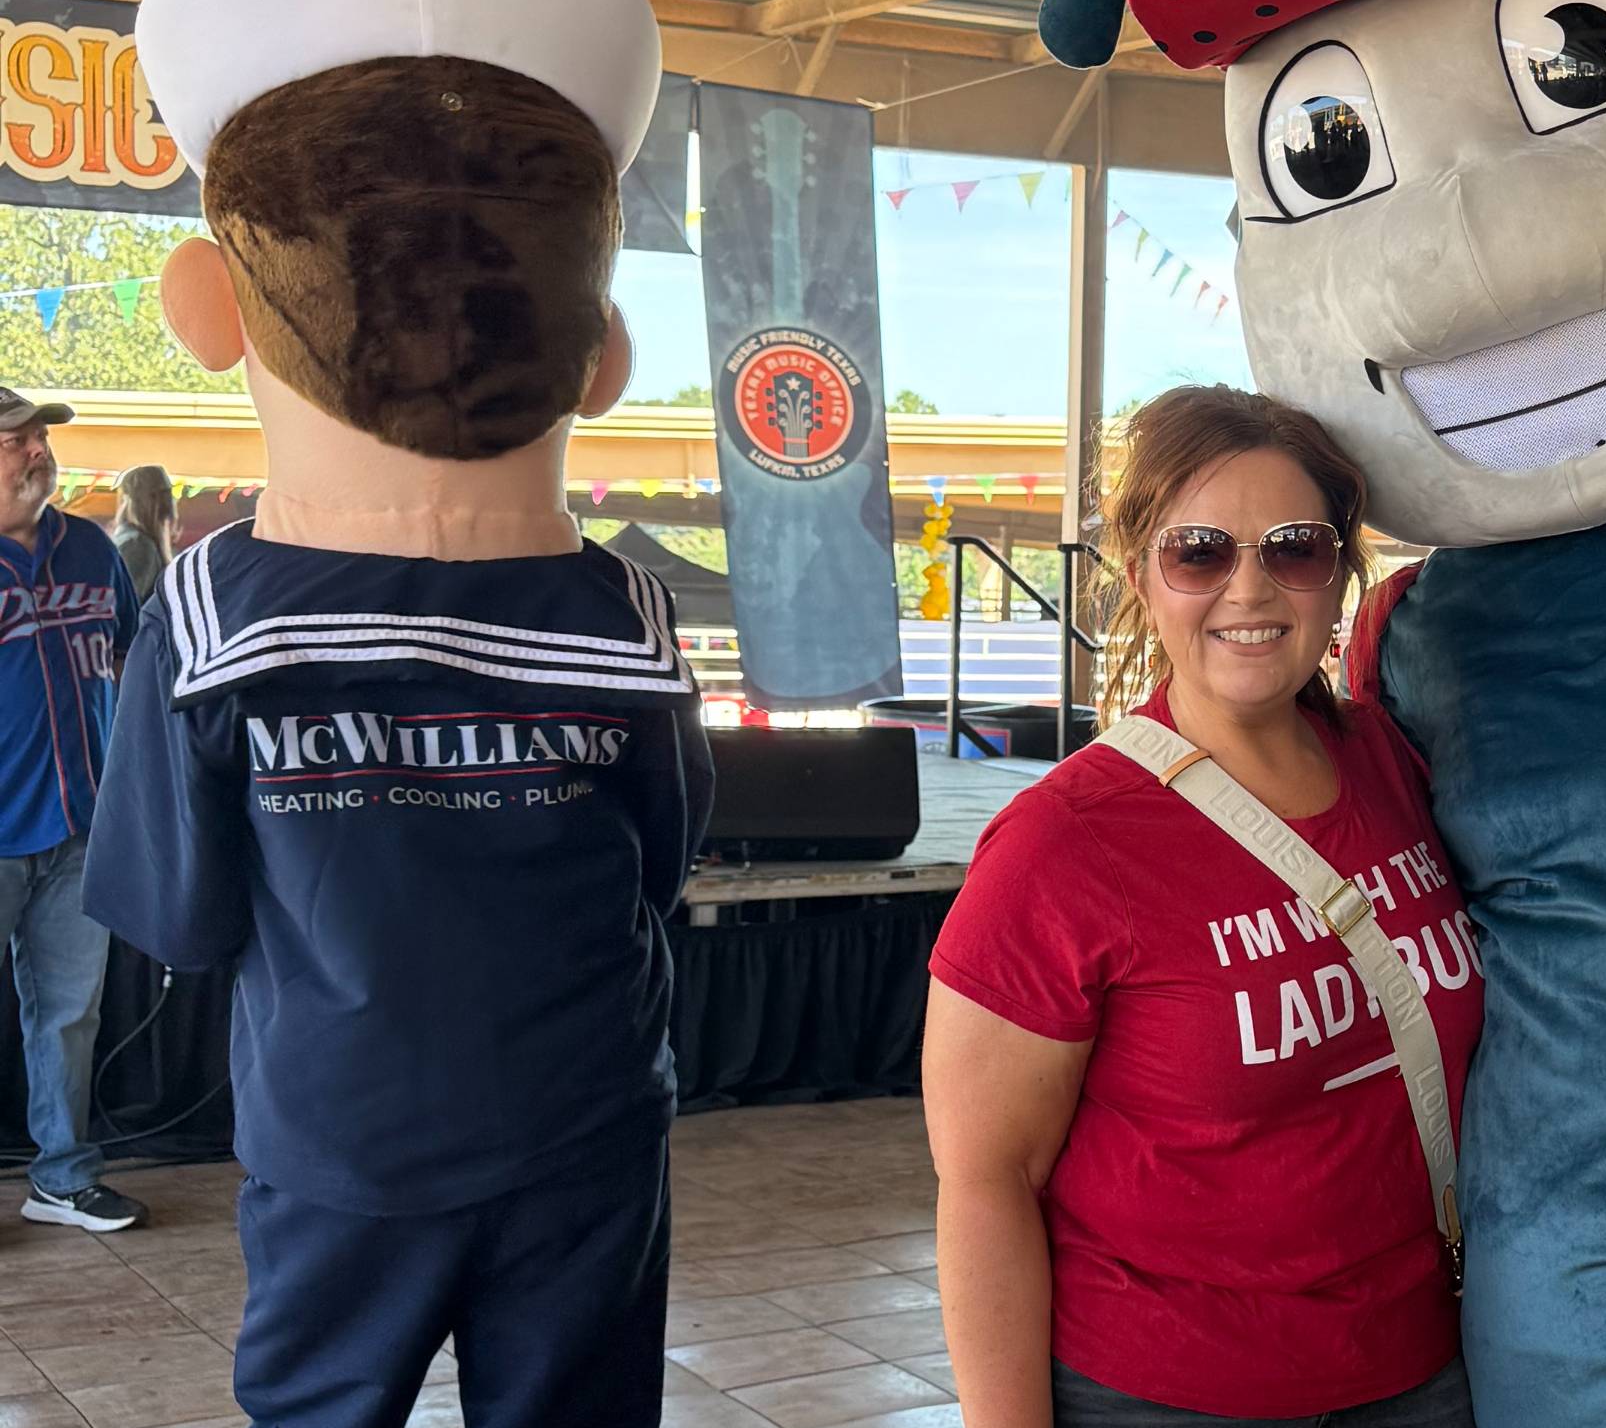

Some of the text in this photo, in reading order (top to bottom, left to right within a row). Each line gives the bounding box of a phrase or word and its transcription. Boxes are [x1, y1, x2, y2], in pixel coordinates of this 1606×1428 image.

[0, 31, 178, 177] SIC
[726, 330, 862, 387] MUSIC FRIENDLY TEXAS
[743, 354, 844, 428] TEXAS MUSIC OFFICE
[802, 454, 846, 478] TEXAS
[258, 787, 364, 814] HEATING
[388, 786, 501, 810] COOLING
[1209, 782, 1316, 876] LOUIS
[1208, 841, 1448, 967] I'M WH THE
[1413, 1063, 1451, 1170] LOUIS
